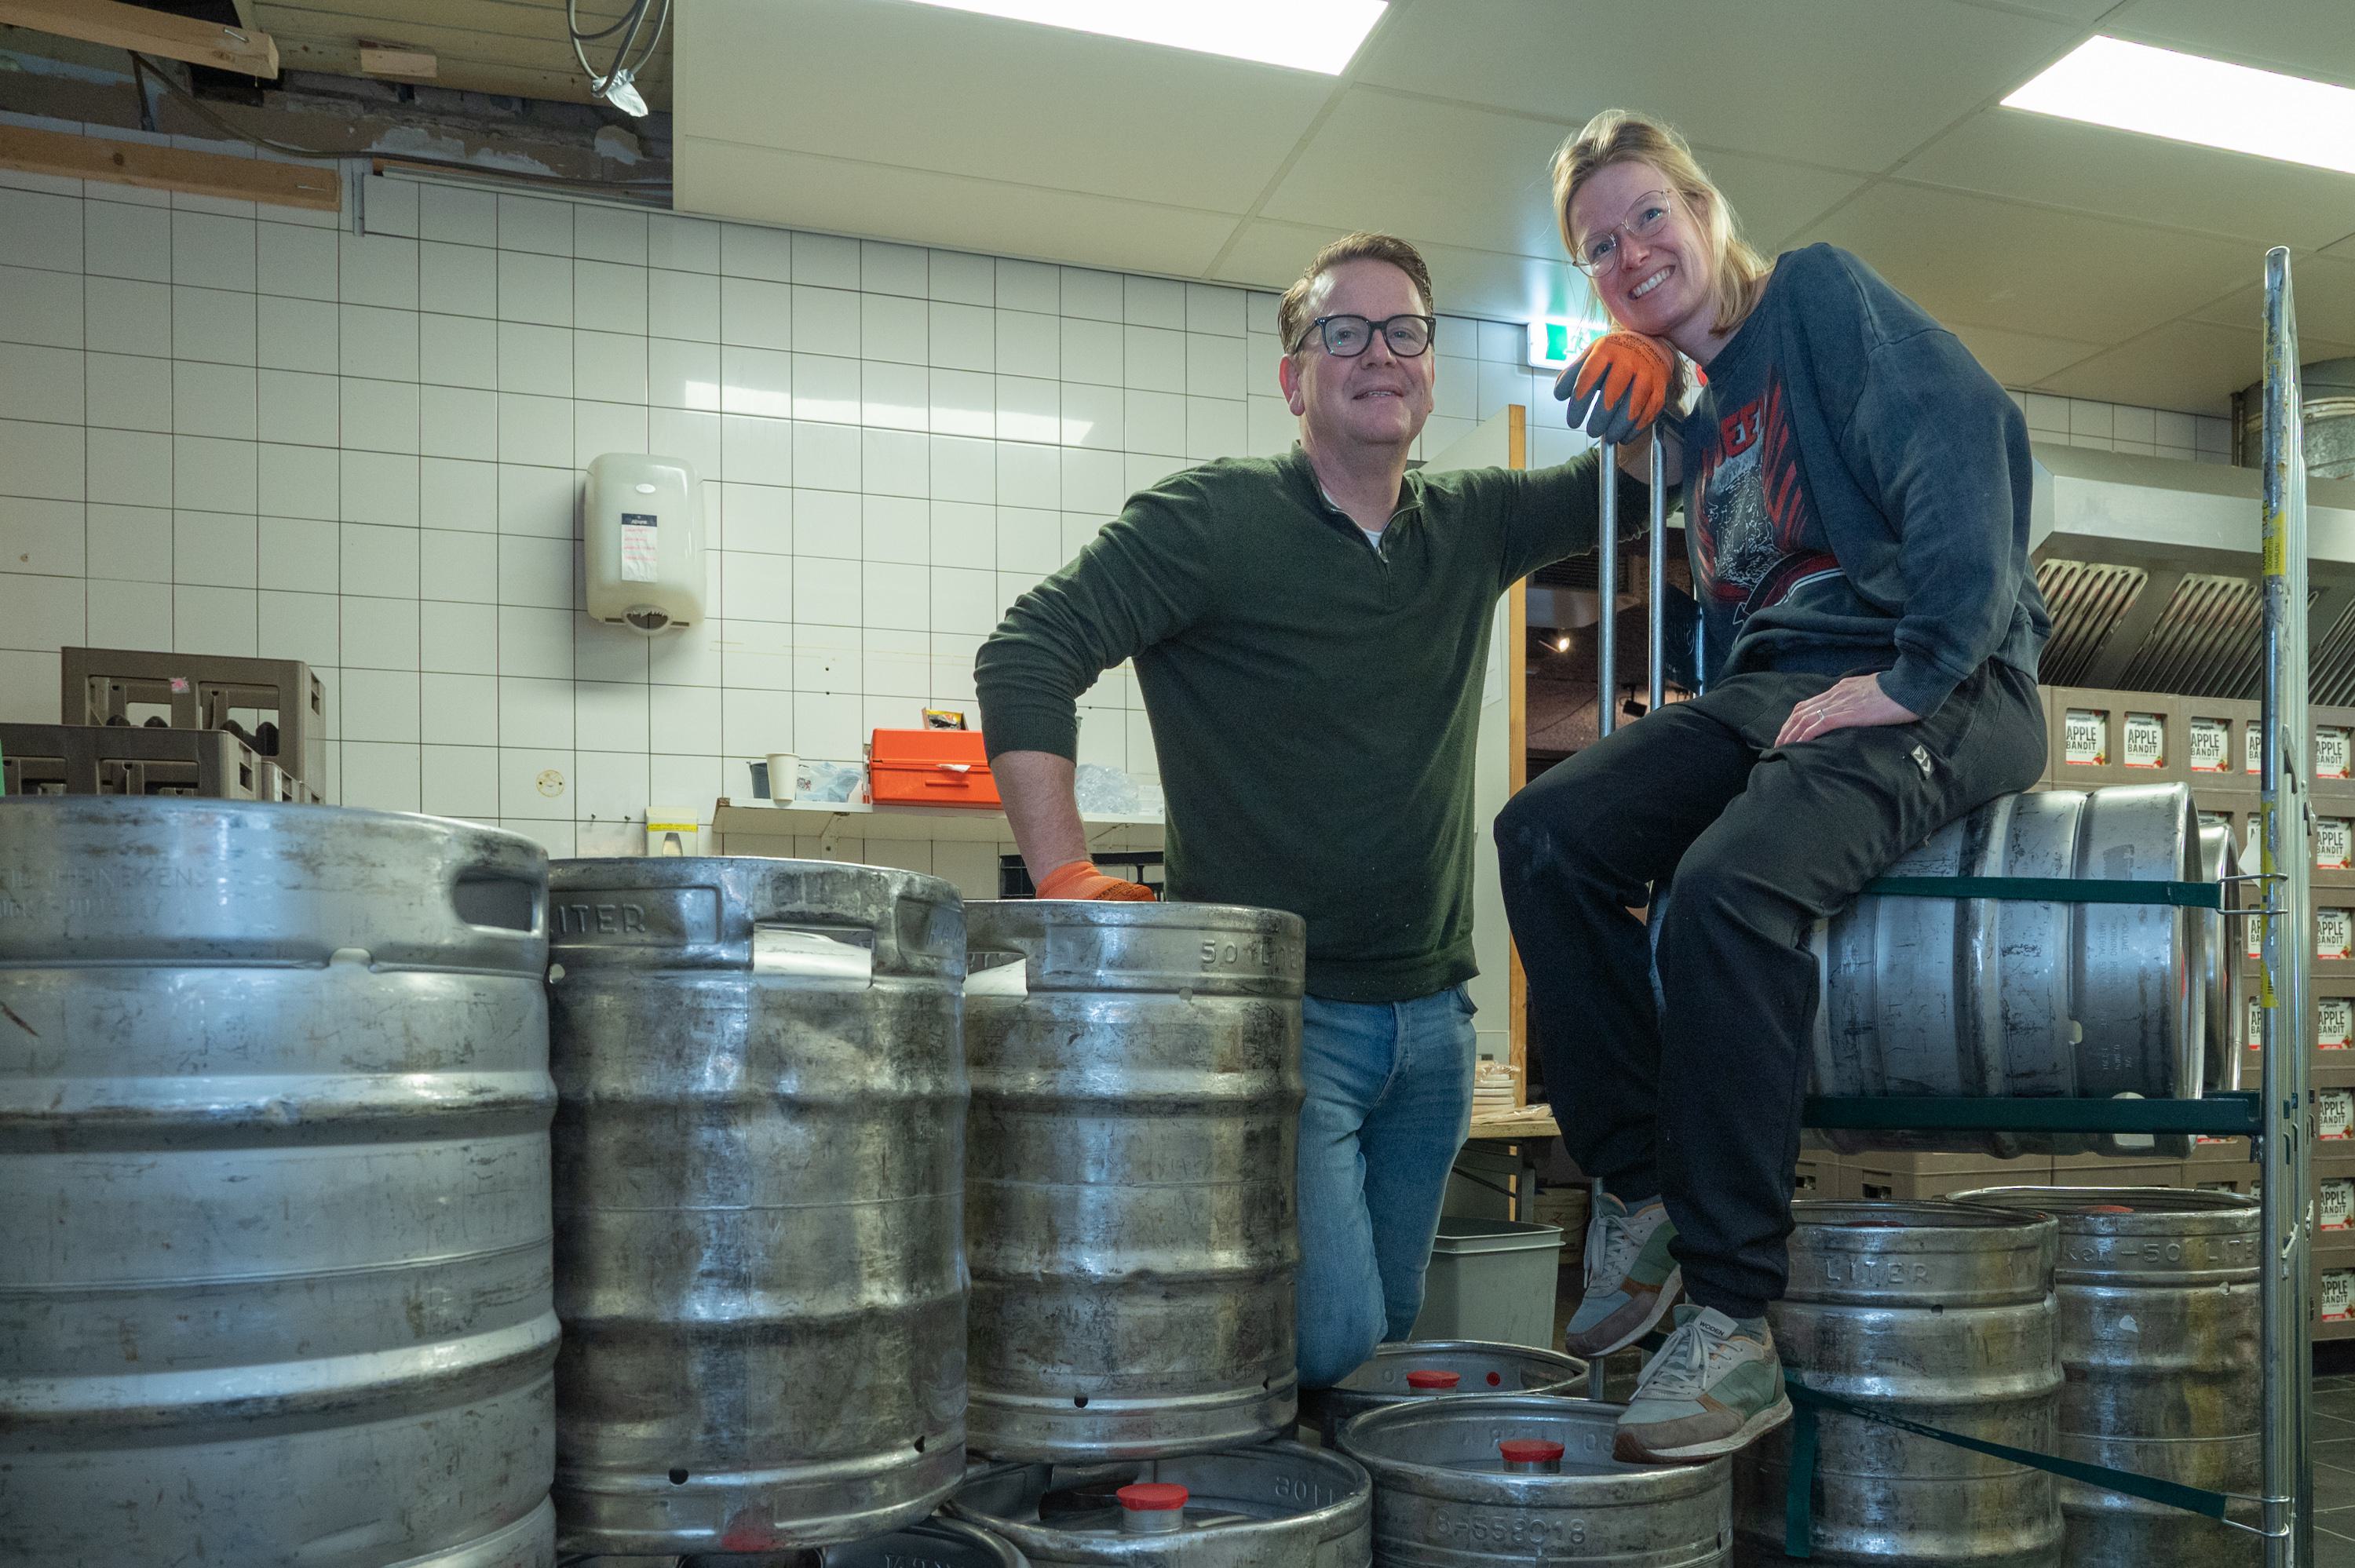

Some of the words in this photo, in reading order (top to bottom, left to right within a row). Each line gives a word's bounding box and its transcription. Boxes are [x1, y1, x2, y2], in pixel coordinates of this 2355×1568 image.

[2066, 725, 2097, 741] APPLE
[2128, 728, 2157, 745] APPLE
[2191, 733, 2219, 748] APPLE
[2065, 742, 2097, 750] BANDIT
[2127, 744, 2157, 753] BANDIT
[2190, 748, 2219, 757] BANDIT
[2317, 741, 2342, 756] APPLE
[2317, 831, 2343, 846] APPLE
[550, 903, 645, 933] ITER
[1199, 939, 1238, 965] 50
[2318, 1011, 2345, 1025] APPLE
[2320, 1101, 2346, 1115] APPLE
[1825, 1257, 1929, 1285] LITER
[1700, 1321, 1725, 1336] WODEN
